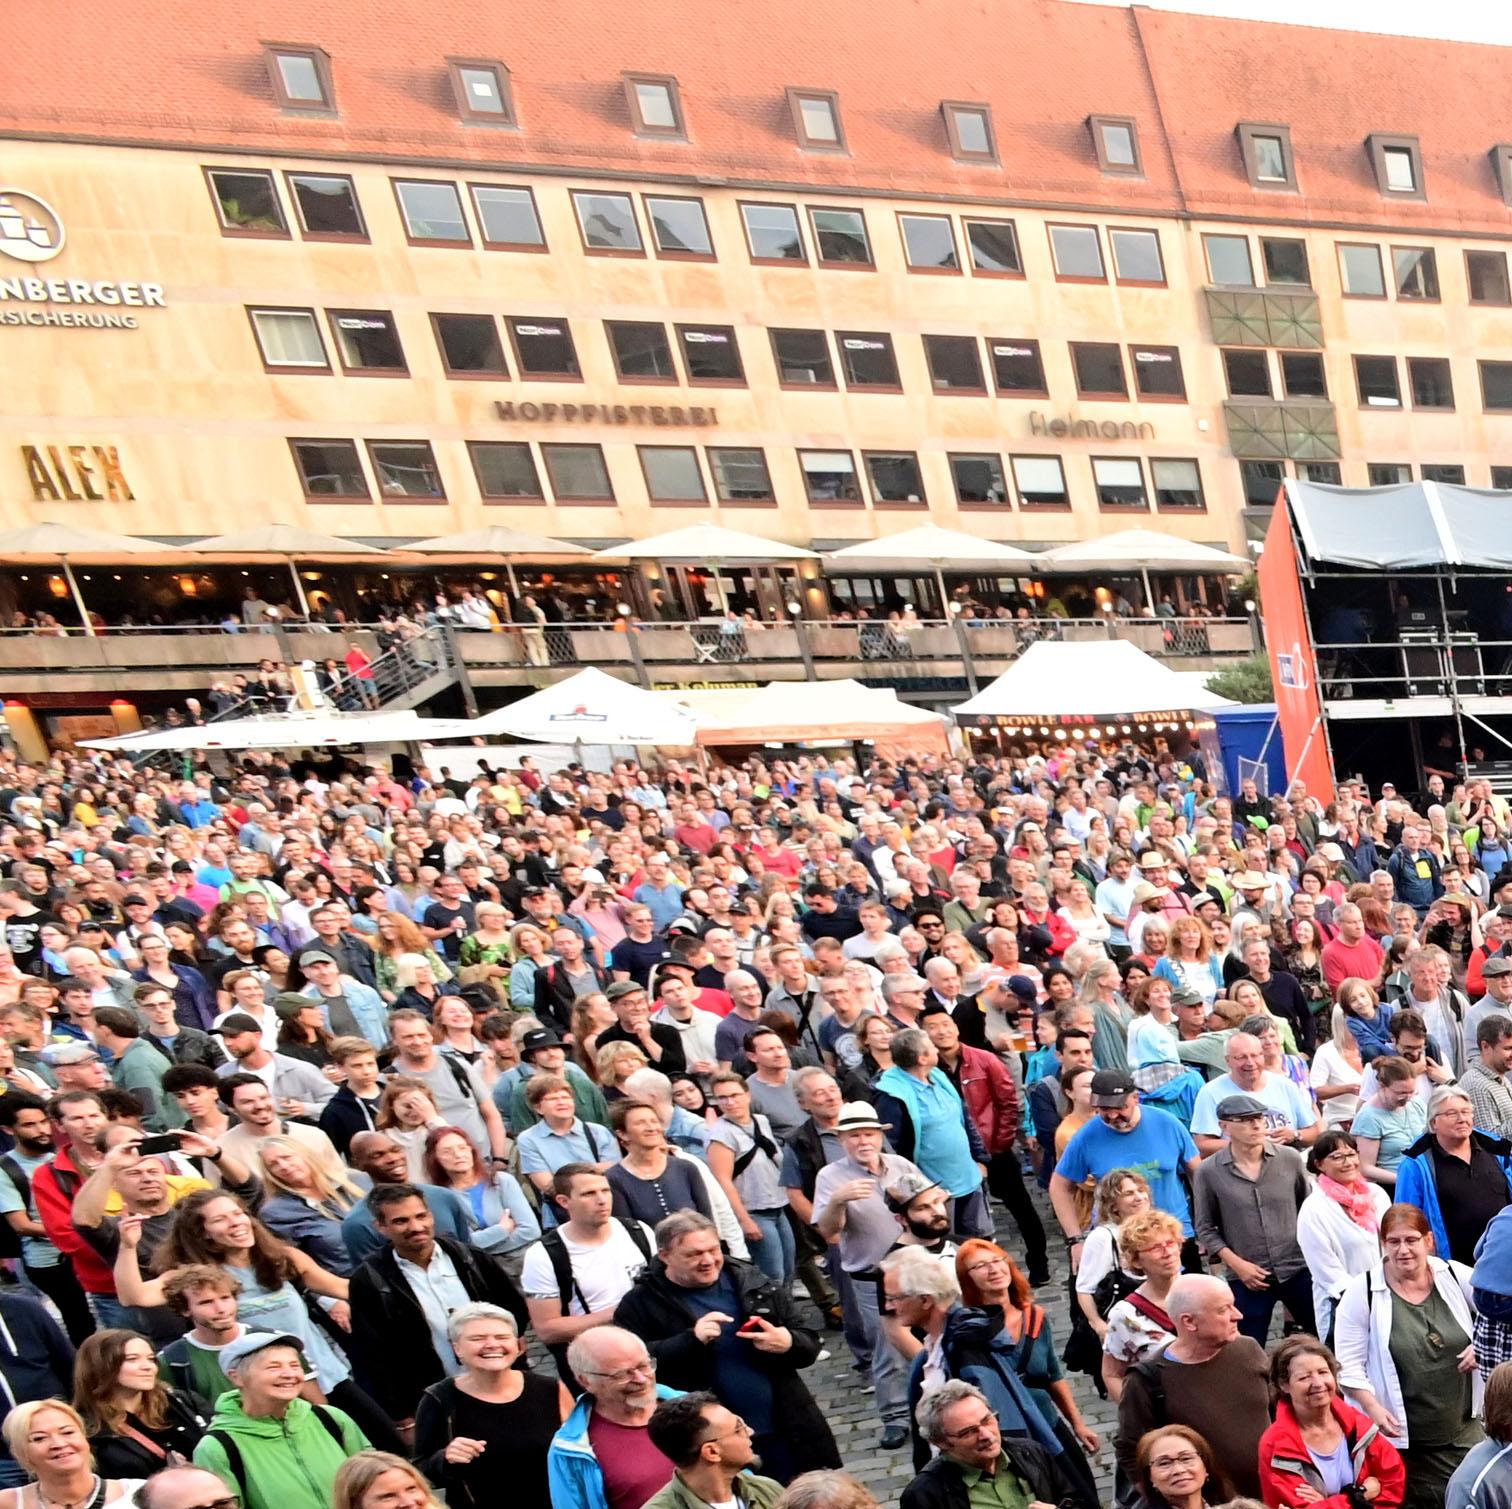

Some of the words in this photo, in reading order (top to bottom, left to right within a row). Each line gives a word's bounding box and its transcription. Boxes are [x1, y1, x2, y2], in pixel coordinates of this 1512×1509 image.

[21, 445, 136, 501] ALEX
[996, 715, 1057, 726] BOWLE
[1060, 714, 1095, 724] BAR
